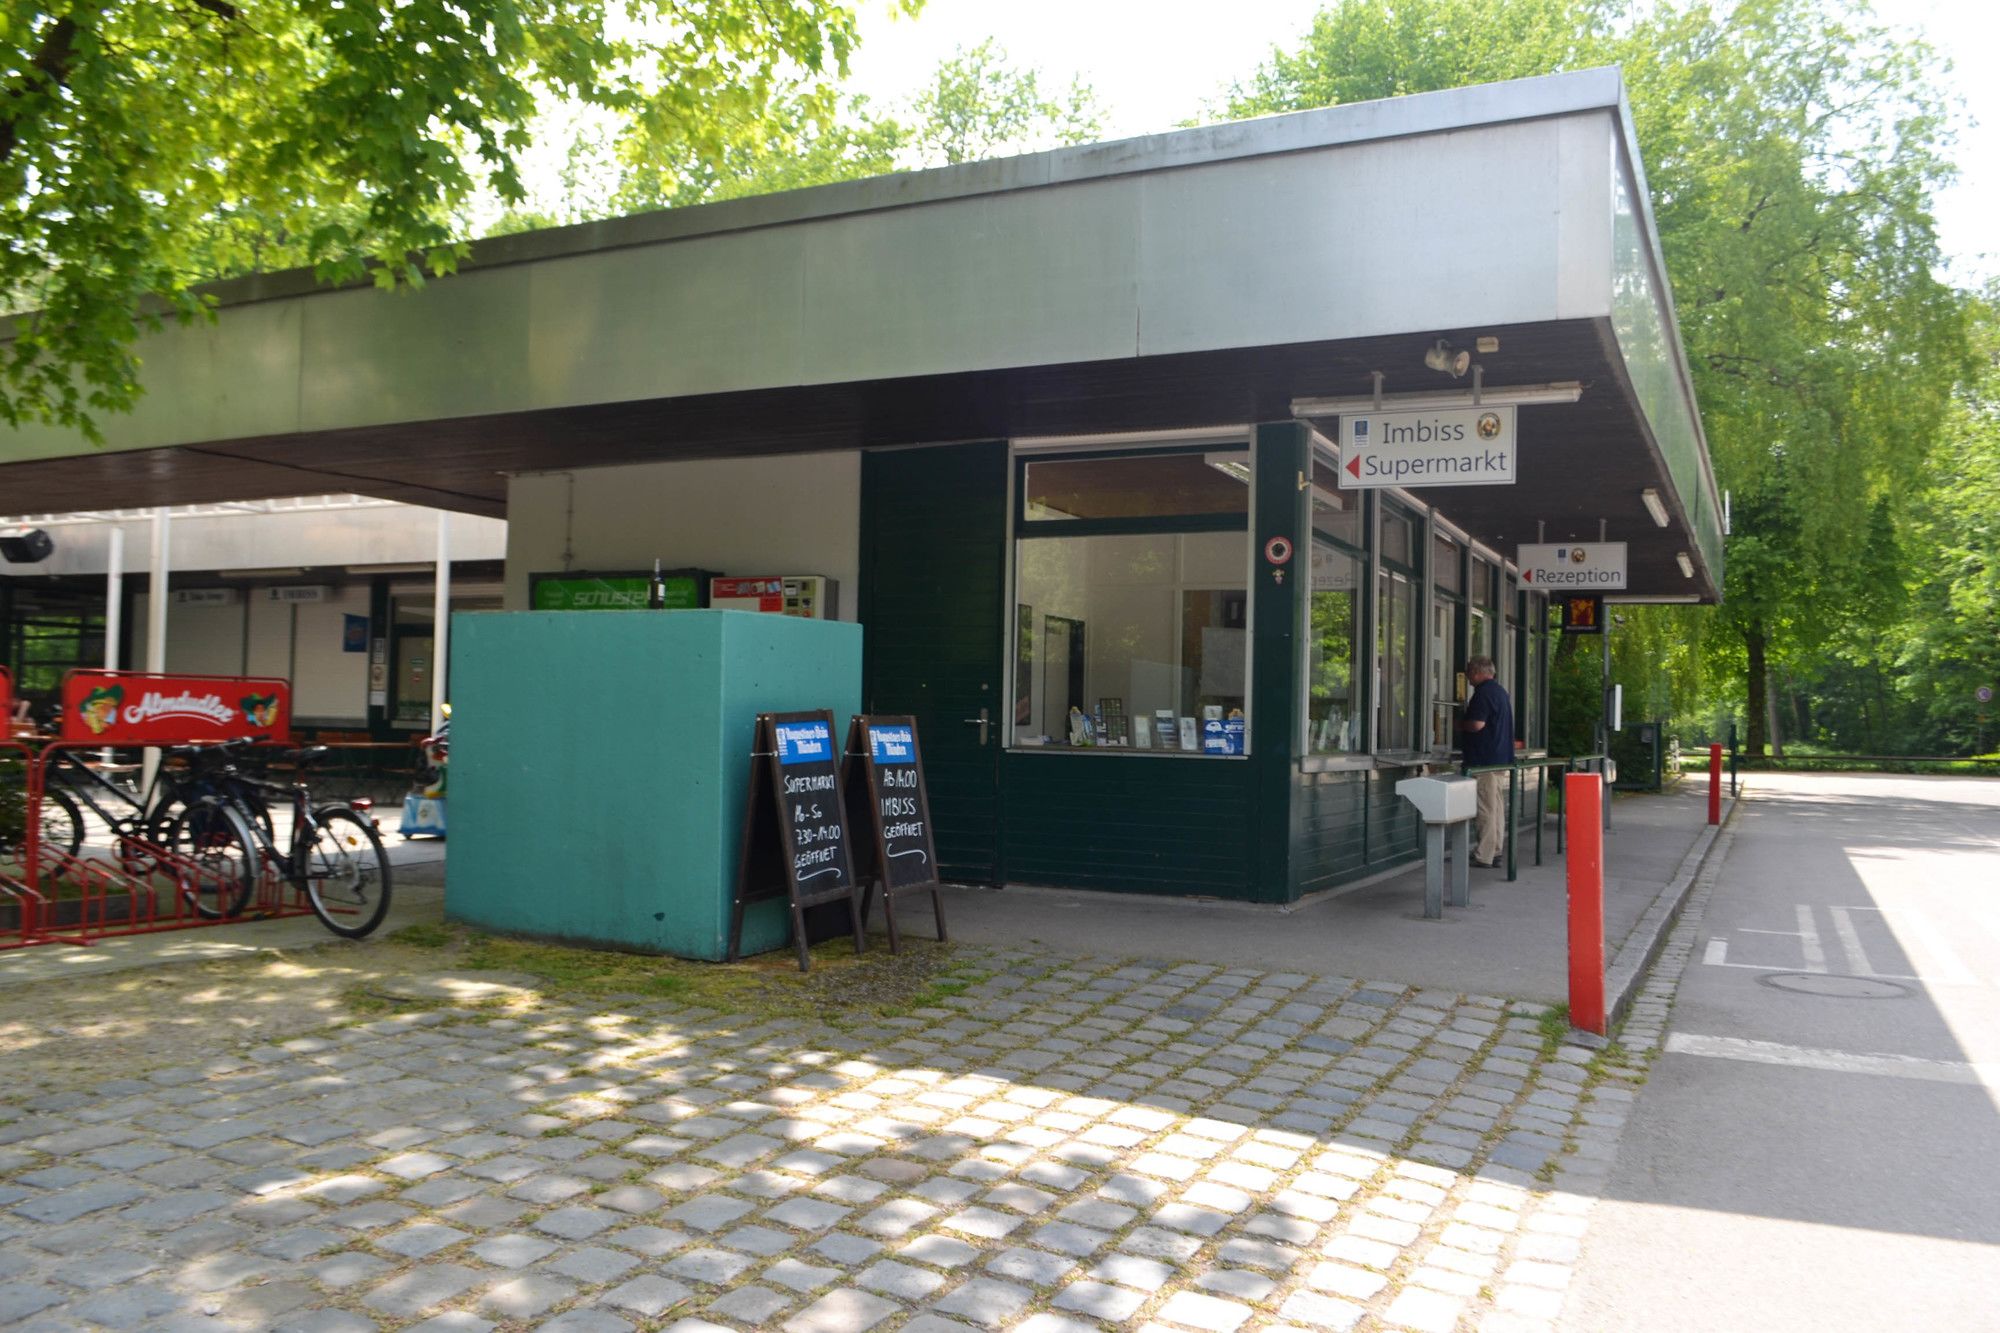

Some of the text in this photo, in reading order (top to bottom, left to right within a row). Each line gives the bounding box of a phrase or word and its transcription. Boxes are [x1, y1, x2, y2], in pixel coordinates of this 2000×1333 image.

[1382, 419, 1465, 444] Imbiss
[1365, 450, 1508, 481] Supermarkt
[1535, 567, 1622, 586] Rezeption
[123, 690, 234, 724] Almdudler
[881, 797, 916, 816] IMBISS
[884, 821, 924, 839] GEÖFFNET
[795, 846, 837, 869] GEÖFFNET
